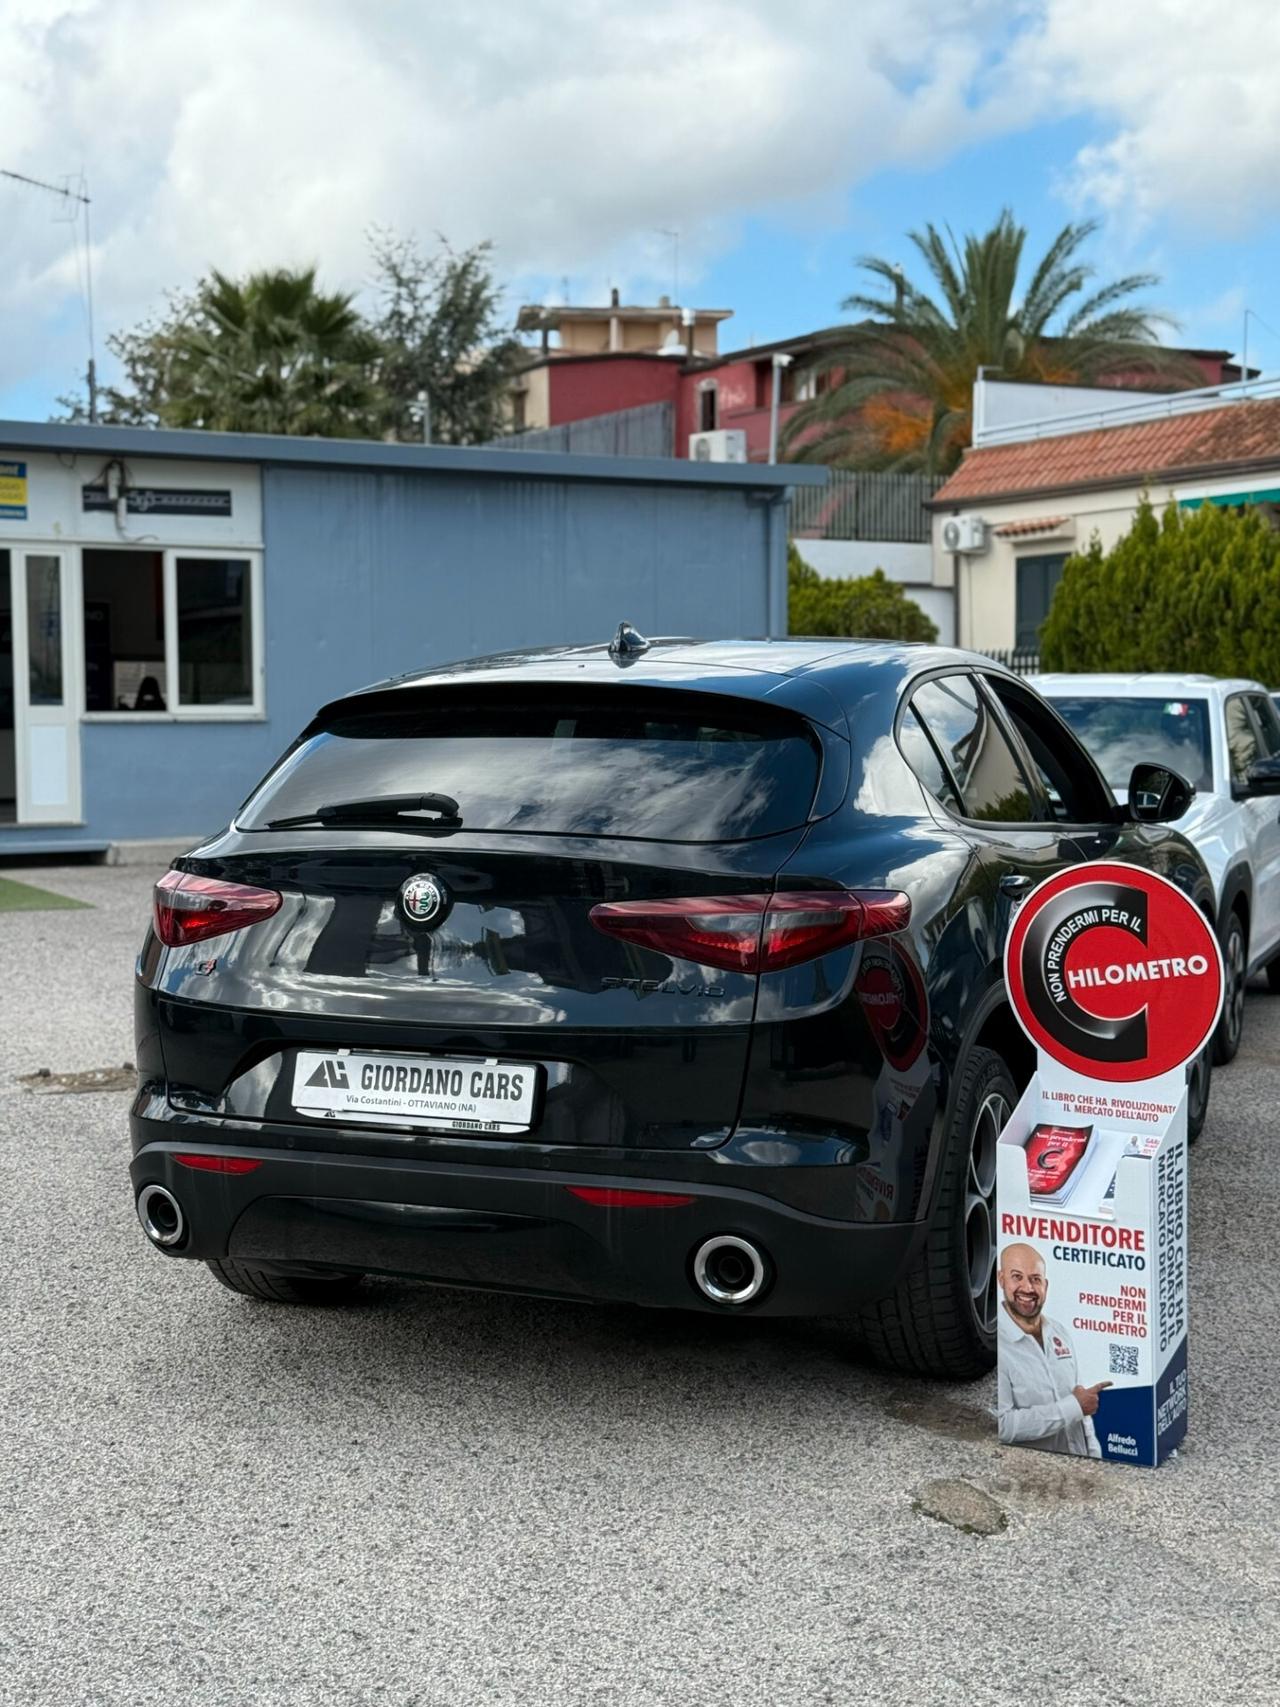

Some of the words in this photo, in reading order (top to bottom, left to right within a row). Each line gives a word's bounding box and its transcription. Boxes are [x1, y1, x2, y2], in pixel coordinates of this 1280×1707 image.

[1101, 909, 1128, 925] PER
[1130, 916, 1141, 932] IL
[1047, 910, 1099, 970] PRENDERMI
[601, 977, 725, 997] STELVIO
[1050, 973, 1067, 1003] NON
[361, 1064, 463, 1097] GIORDANO
[470, 1071, 524, 1101] CARS
[346, 1095, 359, 1104] Via
[360, 1096, 402, 1107] Costantini
[407, 1101, 457, 1111] OTTAVIANO
[458, 1103, 477, 1113] (NA)
[1042, 1091, 1050, 1100] IL
[1051, 1092, 1076, 1103] LIBRO
[1077, 1095, 1094, 1105] CHE
[1095, 1097, 1107, 1106] HA
[1063, 1103, 1071, 1112] IL
[1074, 1105, 1113, 1117] MERCATO
[1115, 1110, 1159, 1123] DELL'AUTO
[452, 1121, 483, 1130] GIORDANO
[484, 1122, 501, 1131] CARS
[1174, 1142, 1183, 1165] IL
[1157, 1154, 1167, 1248] MERCATO
[1174, 1168, 1183, 1241] LIBRO
[1002, 1213, 1145, 1251] RIVENDITORE
[1166, 1147, 1175, 1320] RIVOLUZIONATO
[1053, 1245, 1145, 1271] CERTIFICATO
[1174, 1245, 1184, 1296] CHE
[1079, 1292, 1147, 1312] PRENDERMI
[1120, 1285, 1146, 1299] NON
[1158, 1252, 1167, 1352] DELL'AUTO
[1072, 1317, 1147, 1338] CHILOMETRO
[1112, 1311, 1135, 1324] PER
[1137, 1313, 1147, 1326] IL
[1175, 1298, 1184, 1336] HA
[1167, 1320, 1175, 1345] IL
[1107, 1432, 1136, 1446] Alfredo
[1107, 1443, 1138, 1457] Bellucci
